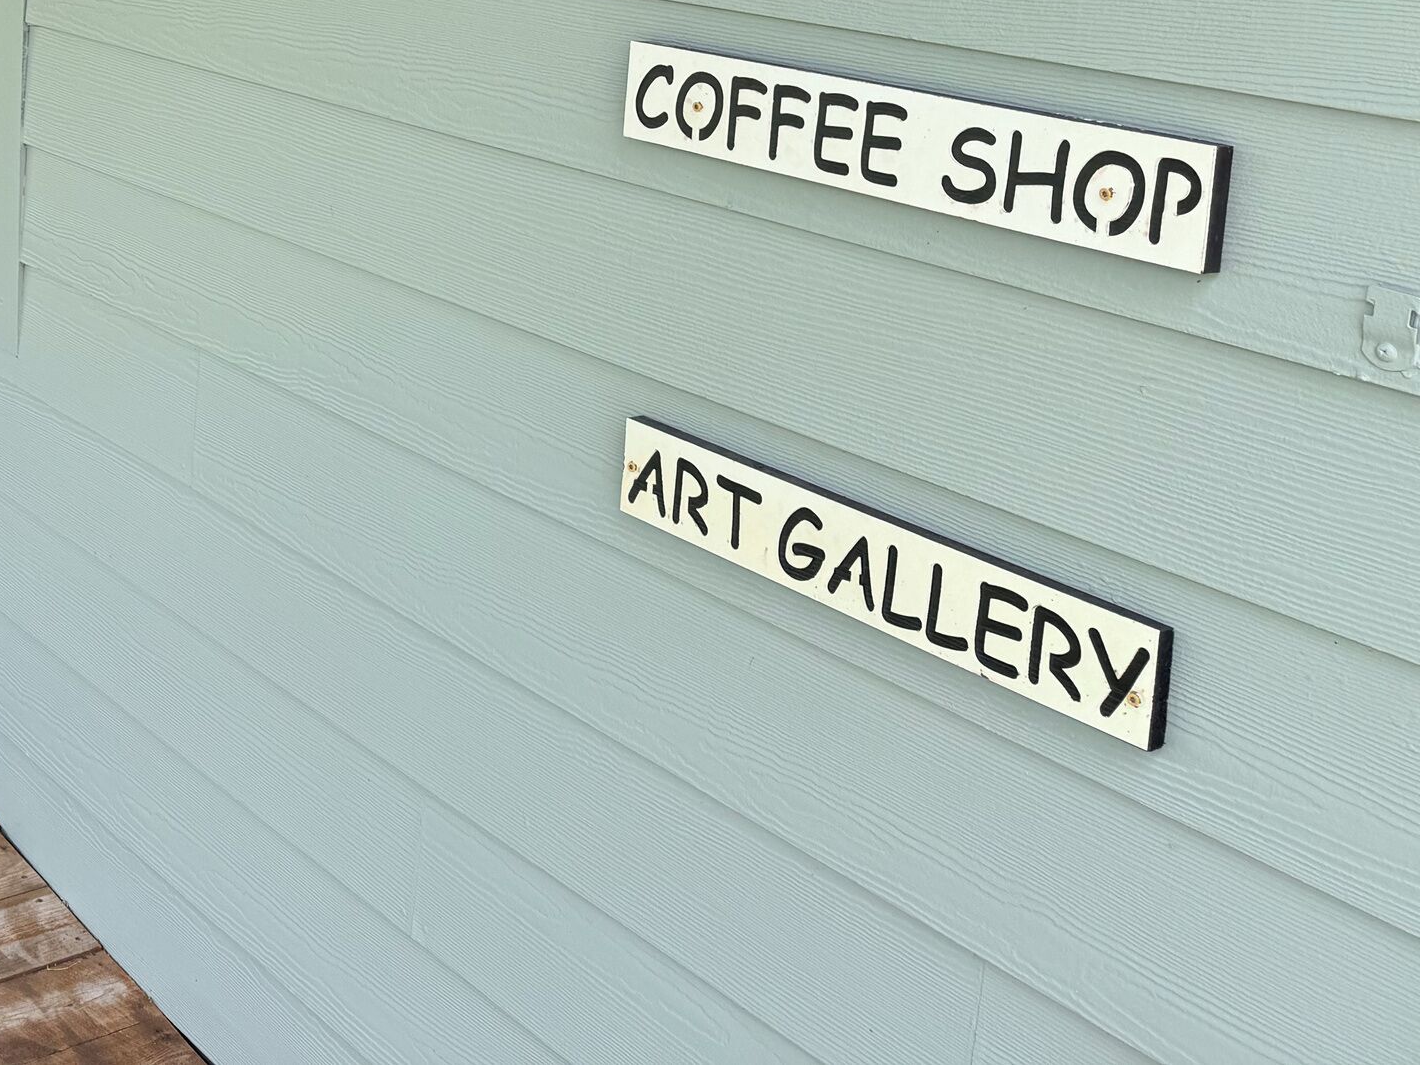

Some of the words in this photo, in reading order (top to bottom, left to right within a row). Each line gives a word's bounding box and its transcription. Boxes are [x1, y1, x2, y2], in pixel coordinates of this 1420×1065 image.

[635, 64, 908, 187] COFFEE
[941, 126, 1203, 245] SHOP
[627, 449, 763, 550] ART
[778, 506, 1151, 717] GALLERY
